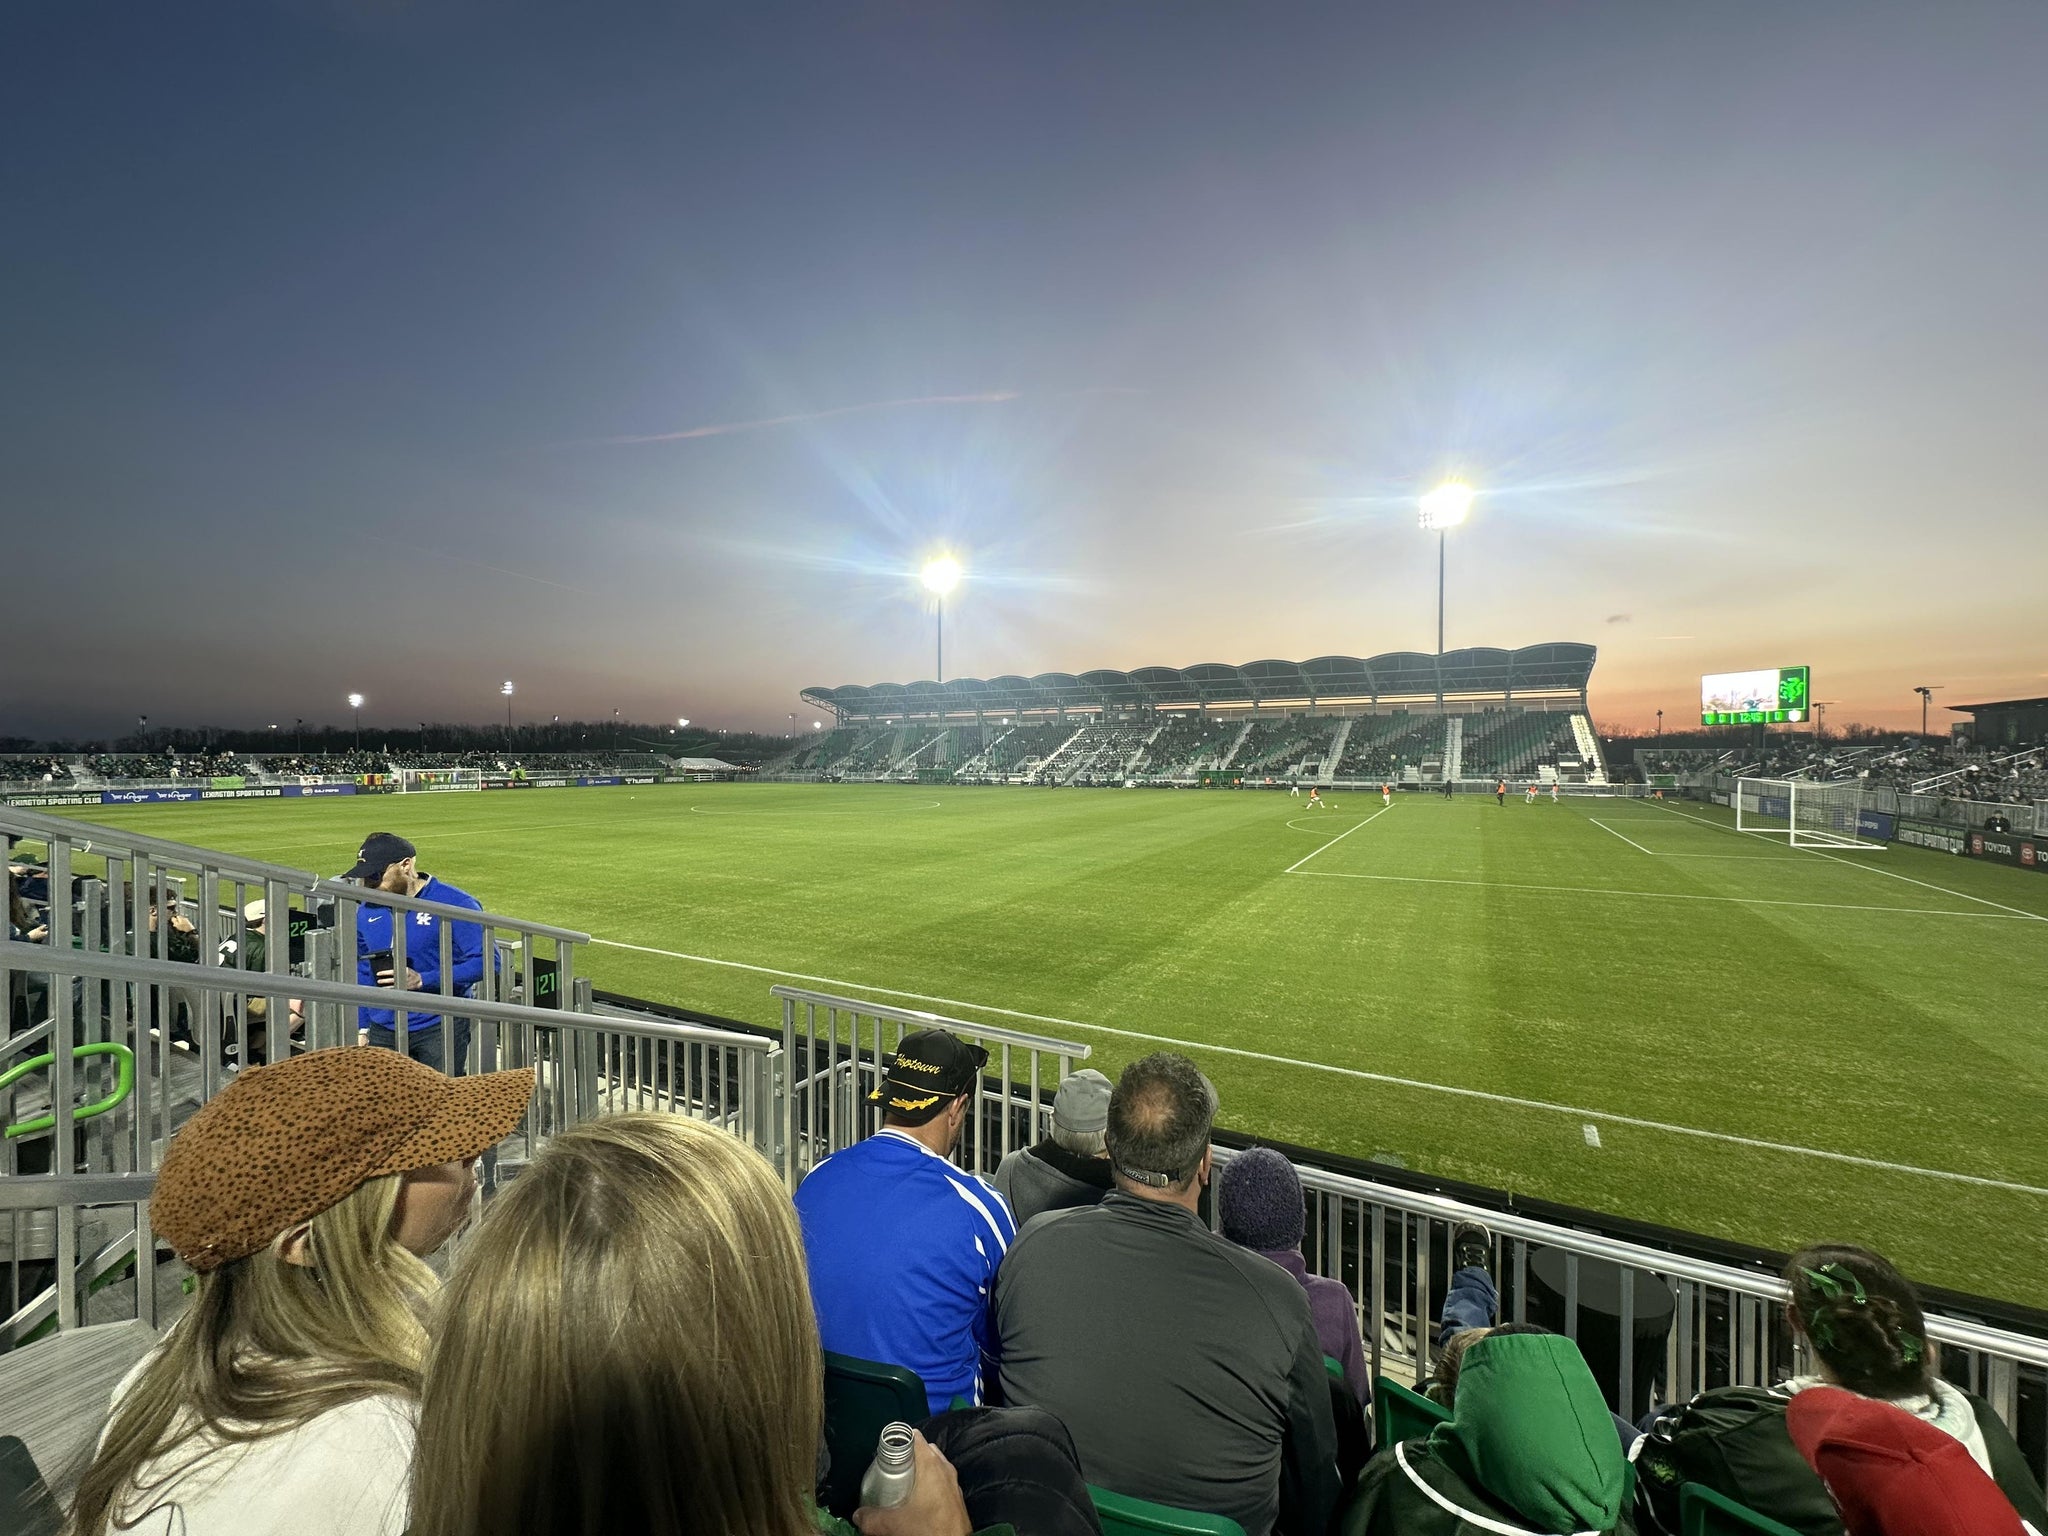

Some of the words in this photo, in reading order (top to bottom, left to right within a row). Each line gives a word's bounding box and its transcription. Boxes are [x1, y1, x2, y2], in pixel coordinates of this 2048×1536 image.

[123, 791, 149, 803] Kroger
[168, 790, 192, 801] Kroger
[202, 790, 235, 799] LEXINGTON
[236, 789, 265, 798] SPORTING
[48, 797, 83, 806] SPORTING
[84, 796, 102, 804] CLUB
[1984, 841, 2012, 856] TOYOTA
